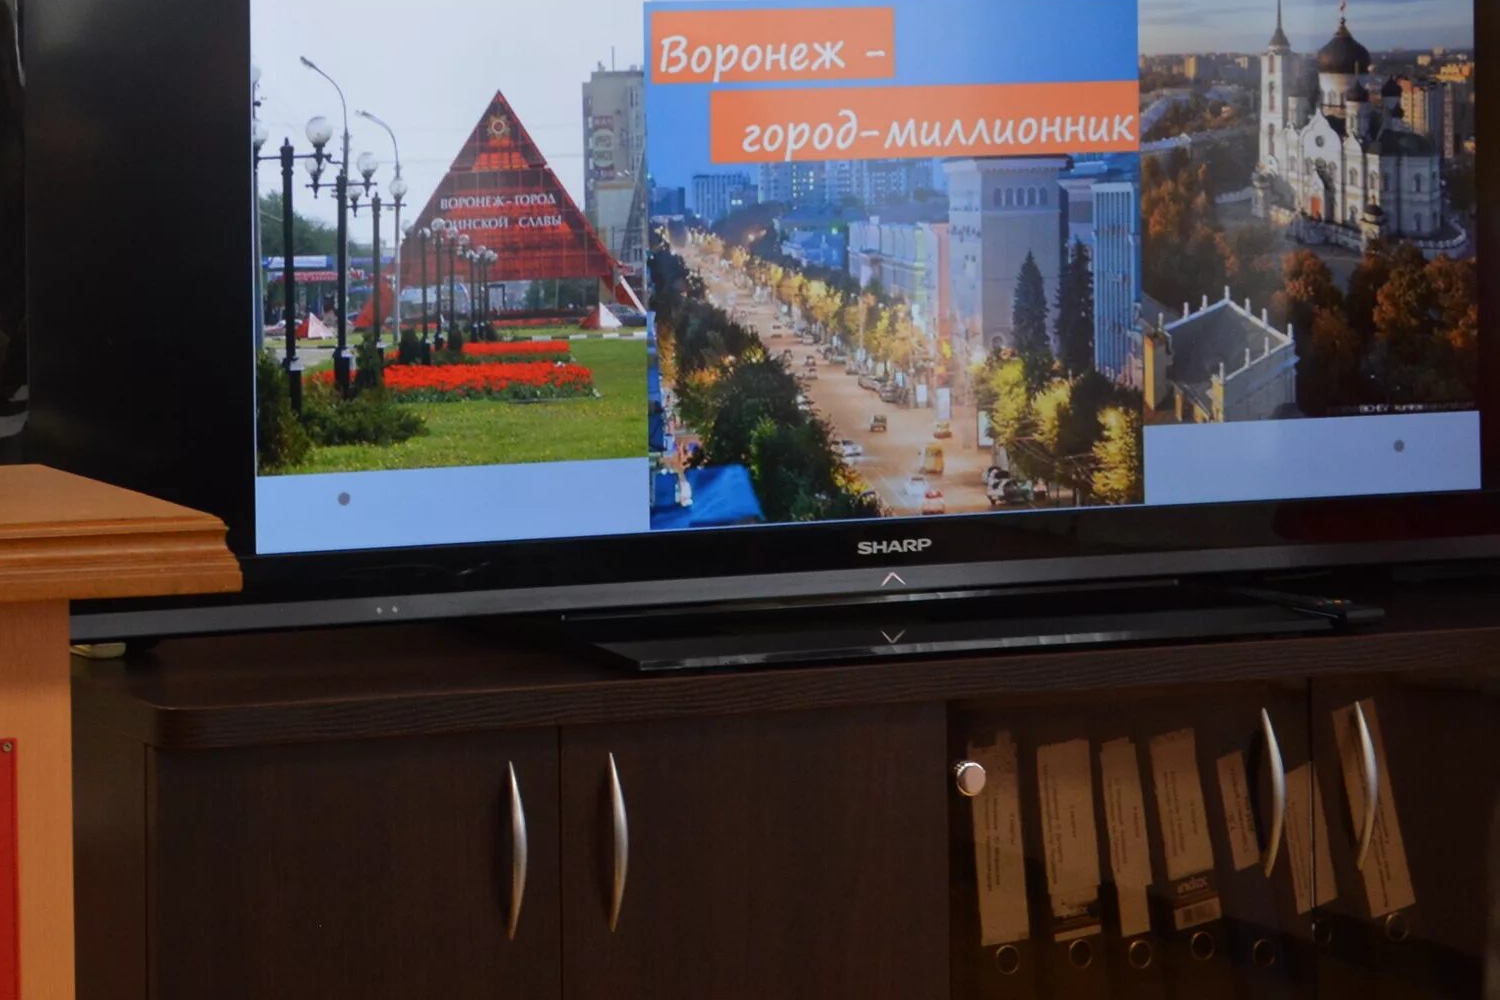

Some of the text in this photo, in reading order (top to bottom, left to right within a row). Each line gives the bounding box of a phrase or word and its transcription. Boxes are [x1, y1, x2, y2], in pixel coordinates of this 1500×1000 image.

[660, 35, 846, 83] Воронеж
[742, 110, 1135, 162] город-миллионник
[433, 214, 562, 231] ОИНСКОЙ СЛАВЫ
[857, 538, 933, 555] SHARP
